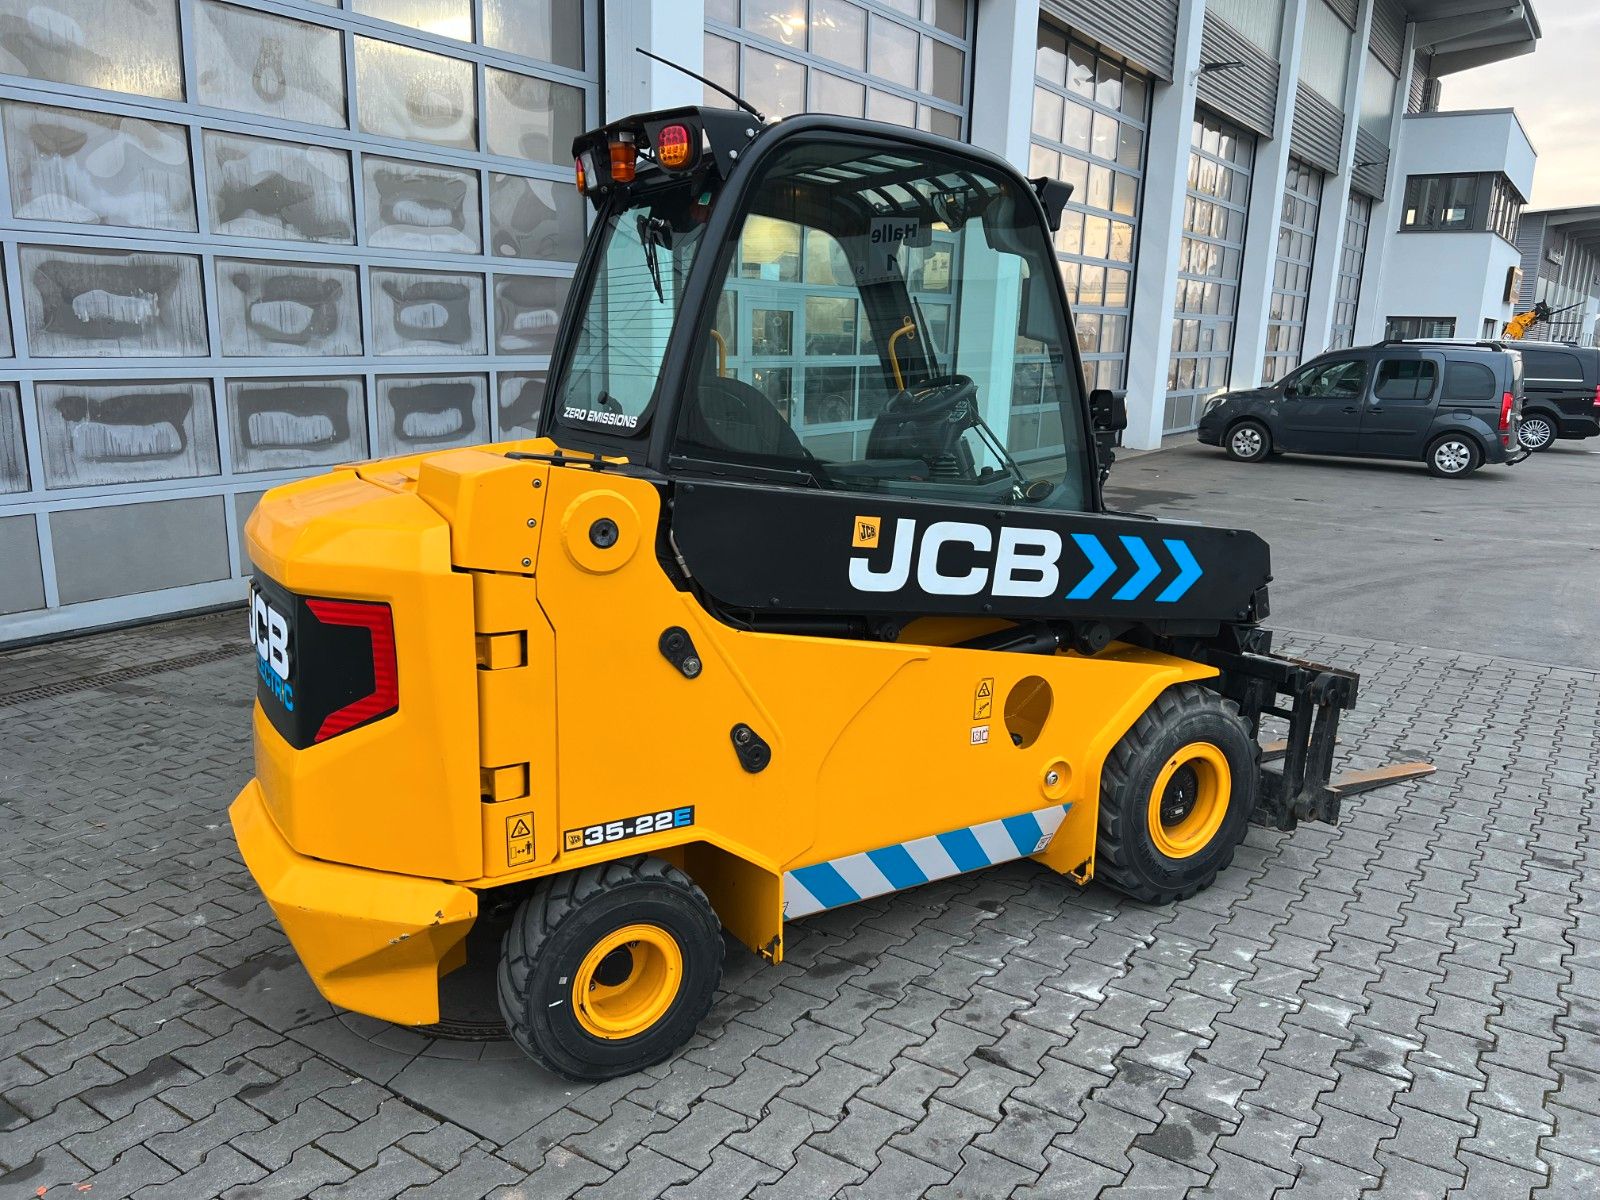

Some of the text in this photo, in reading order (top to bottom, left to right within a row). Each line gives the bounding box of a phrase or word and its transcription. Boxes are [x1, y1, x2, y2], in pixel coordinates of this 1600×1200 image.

[563, 406, 638, 428] ZERO EMISSIONS
[860, 523, 877, 540] JCB
[848, 518, 1063, 598] JCB
[584, 807, 692, 847] 35-22E
